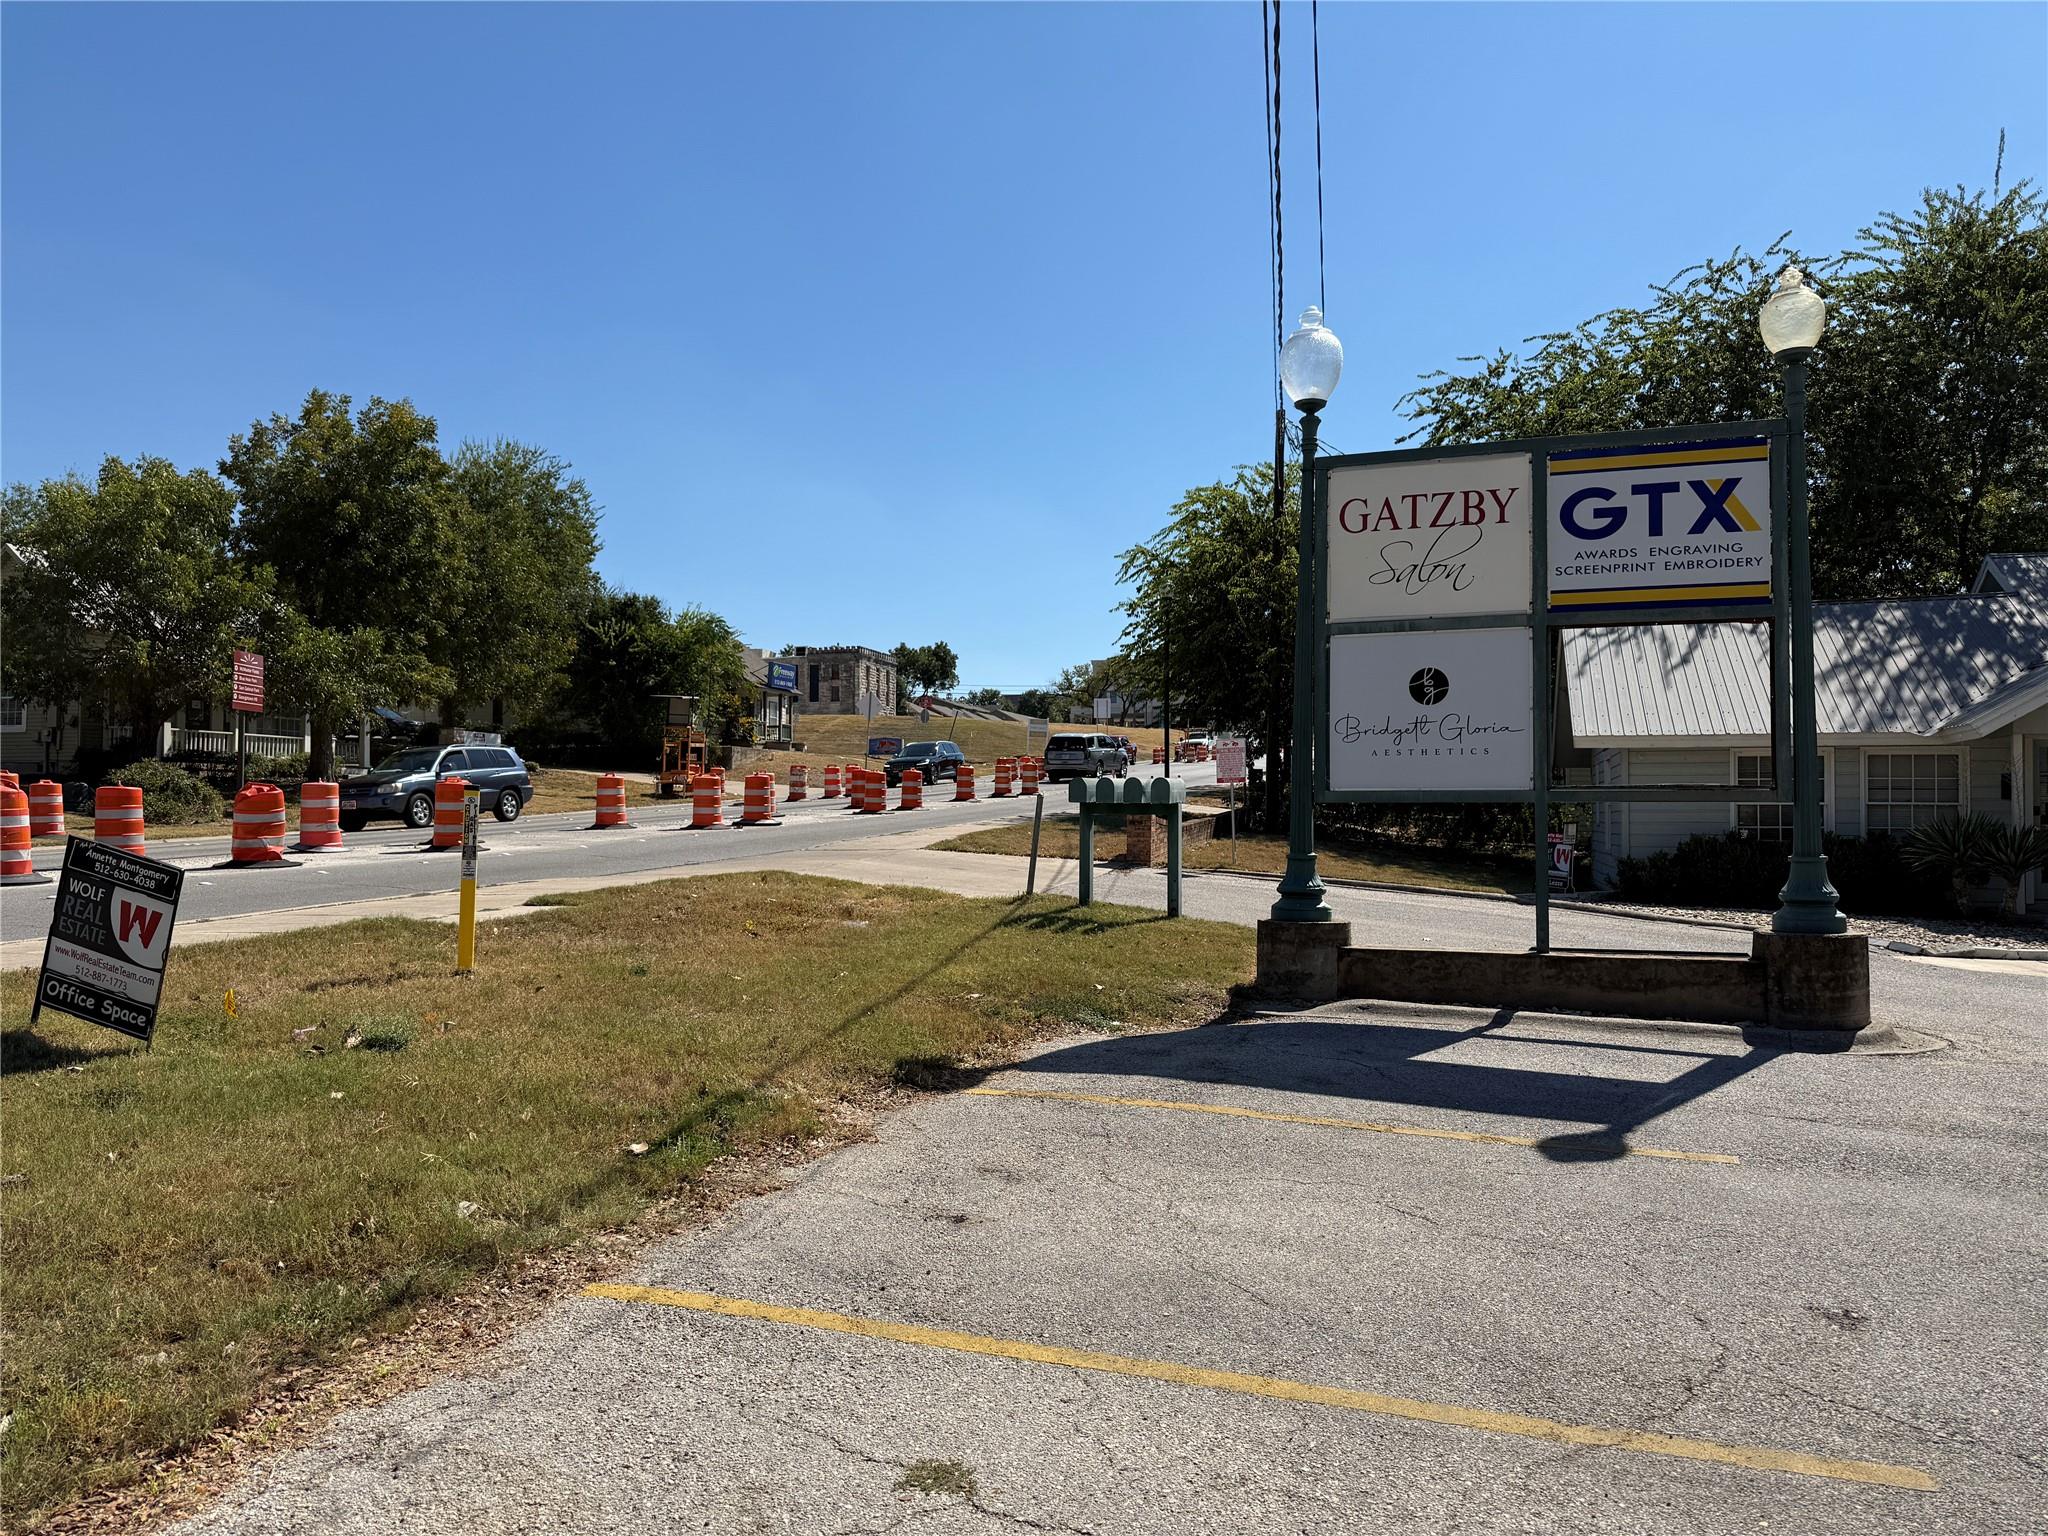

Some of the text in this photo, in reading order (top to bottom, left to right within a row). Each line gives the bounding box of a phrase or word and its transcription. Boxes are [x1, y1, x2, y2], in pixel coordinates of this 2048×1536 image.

[1339, 487, 1519, 534] GATZBY
[1559, 477, 1763, 541] GTX
[1368, 520, 1483, 595] Salon
[1555, 555, 1764, 576] SCREENPRINT EMBROIDERY
[1574, 542, 1744, 561] AWARDS ENGRAVING
[1334, 713, 1526, 746] Bridgett Gloria
[1371, 746, 1491, 757] AESTHETICS
[85, 848, 170, 884] Annette Montgomery
[94, 862, 156, 889] 512-630-4038
[69, 877, 106, 902] WOLF
[62, 894, 104, 926] REAL
[58, 915, 107, 946] ESTATE
[54, 944, 155, 986] www.WolfRealEstateTeam.com
[75, 965, 128, 991] 512-887-1773
[46, 980, 147, 1028] Office Space
